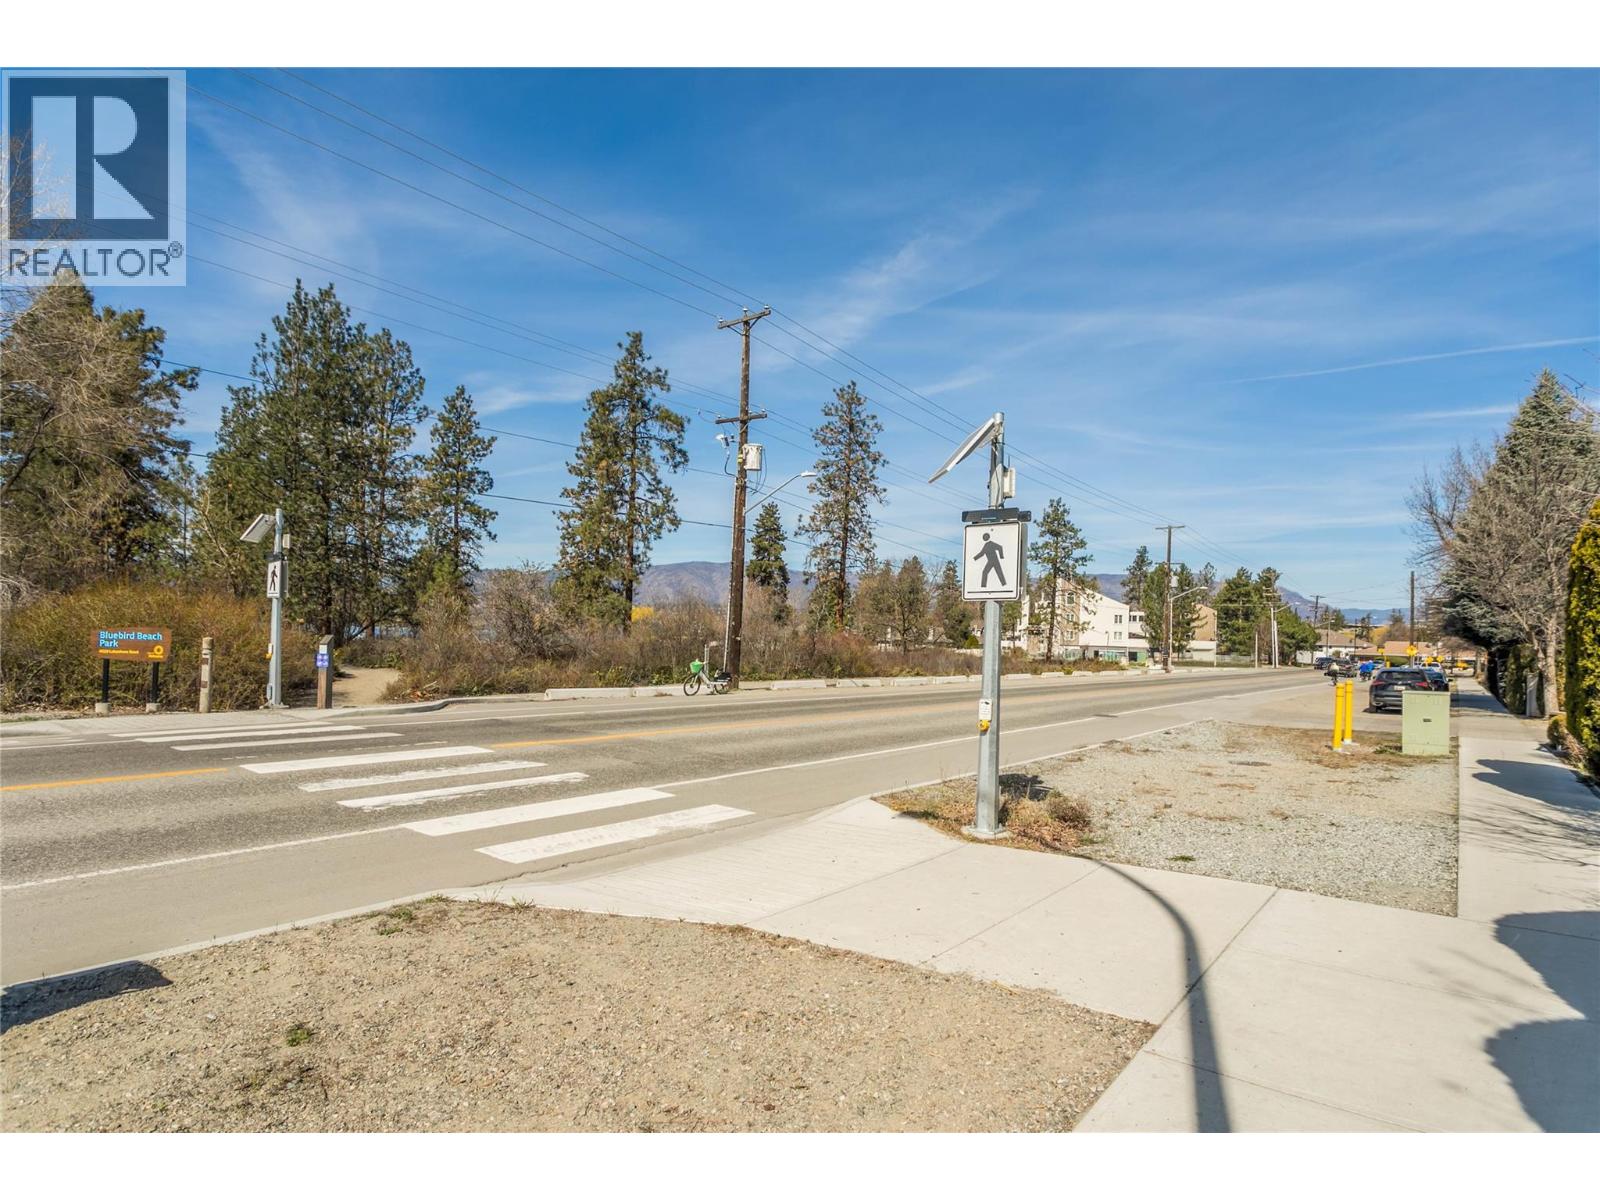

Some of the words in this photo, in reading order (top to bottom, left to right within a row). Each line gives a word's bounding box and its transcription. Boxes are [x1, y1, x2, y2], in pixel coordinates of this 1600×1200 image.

[99, 631, 135, 640] Bluebird
[137, 632, 163, 641] Beach
[99, 639, 119, 648] Park
